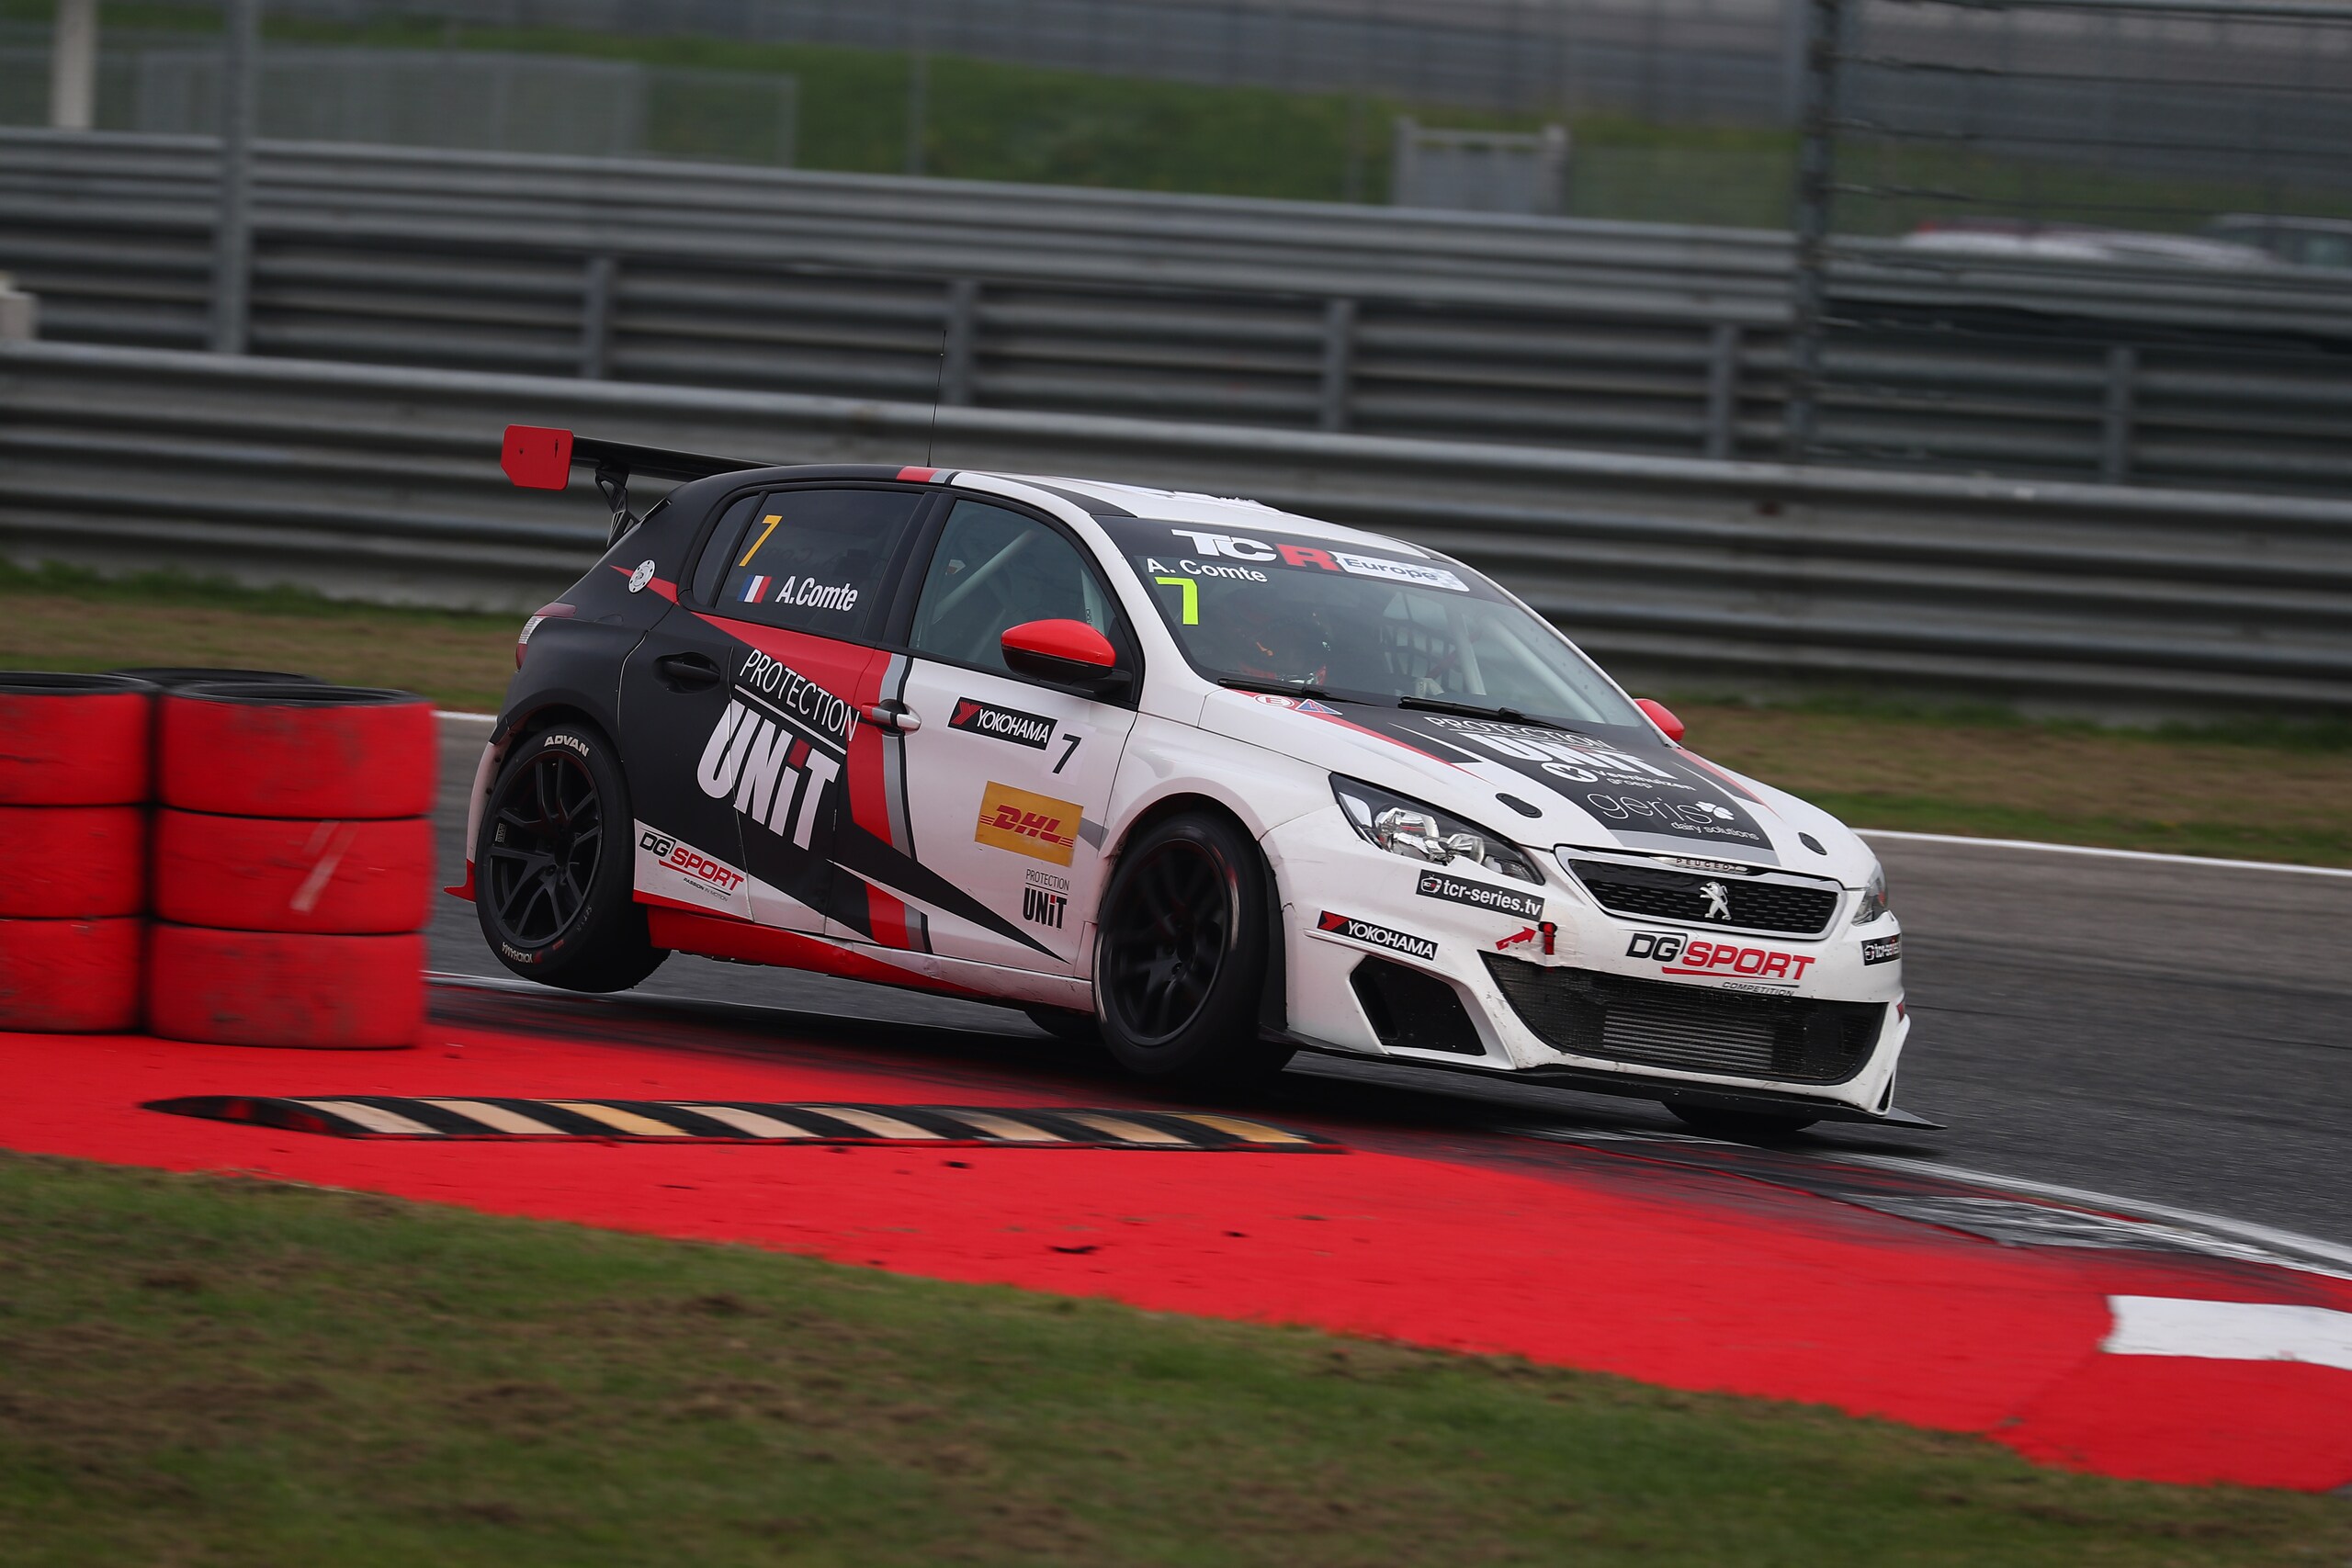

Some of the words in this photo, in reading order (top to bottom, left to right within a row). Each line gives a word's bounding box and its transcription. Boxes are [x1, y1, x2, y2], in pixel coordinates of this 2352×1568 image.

[739, 514, 783, 567] 7
[1171, 529, 1342, 572] TCR
[1343, 558, 1439, 581] Europe
[1147, 558, 1176, 574] A.
[1179, 559, 1268, 582] Comte
[1154, 576, 1198, 626] 7
[739, 649, 860, 742] PROTECTION
[977, 708, 1050, 743] YOKOHAMA
[1423, 716, 1619, 751] PROTECTION
[544, 735, 589, 758] ADVAN
[1052, 733, 1082, 774] 7
[991, 804, 1060, 843] DHL
[1587, 793, 1713, 824] geris
[1670, 820, 1702, 834] dairy
[1704, 823, 1760, 840] solutions
[670, 847, 745, 891] SPORT
[1025, 868, 1070, 891] PROTECTION
[1676, 858, 1739, 871] PEUGEOT
[1443, 879, 1543, 917] tcr-series.tv
[1347, 919, 1435, 958] YOKOHAMA
[1682, 941, 1816, 980] SPORT
[1722, 981, 1795, 997] COMPETITION
